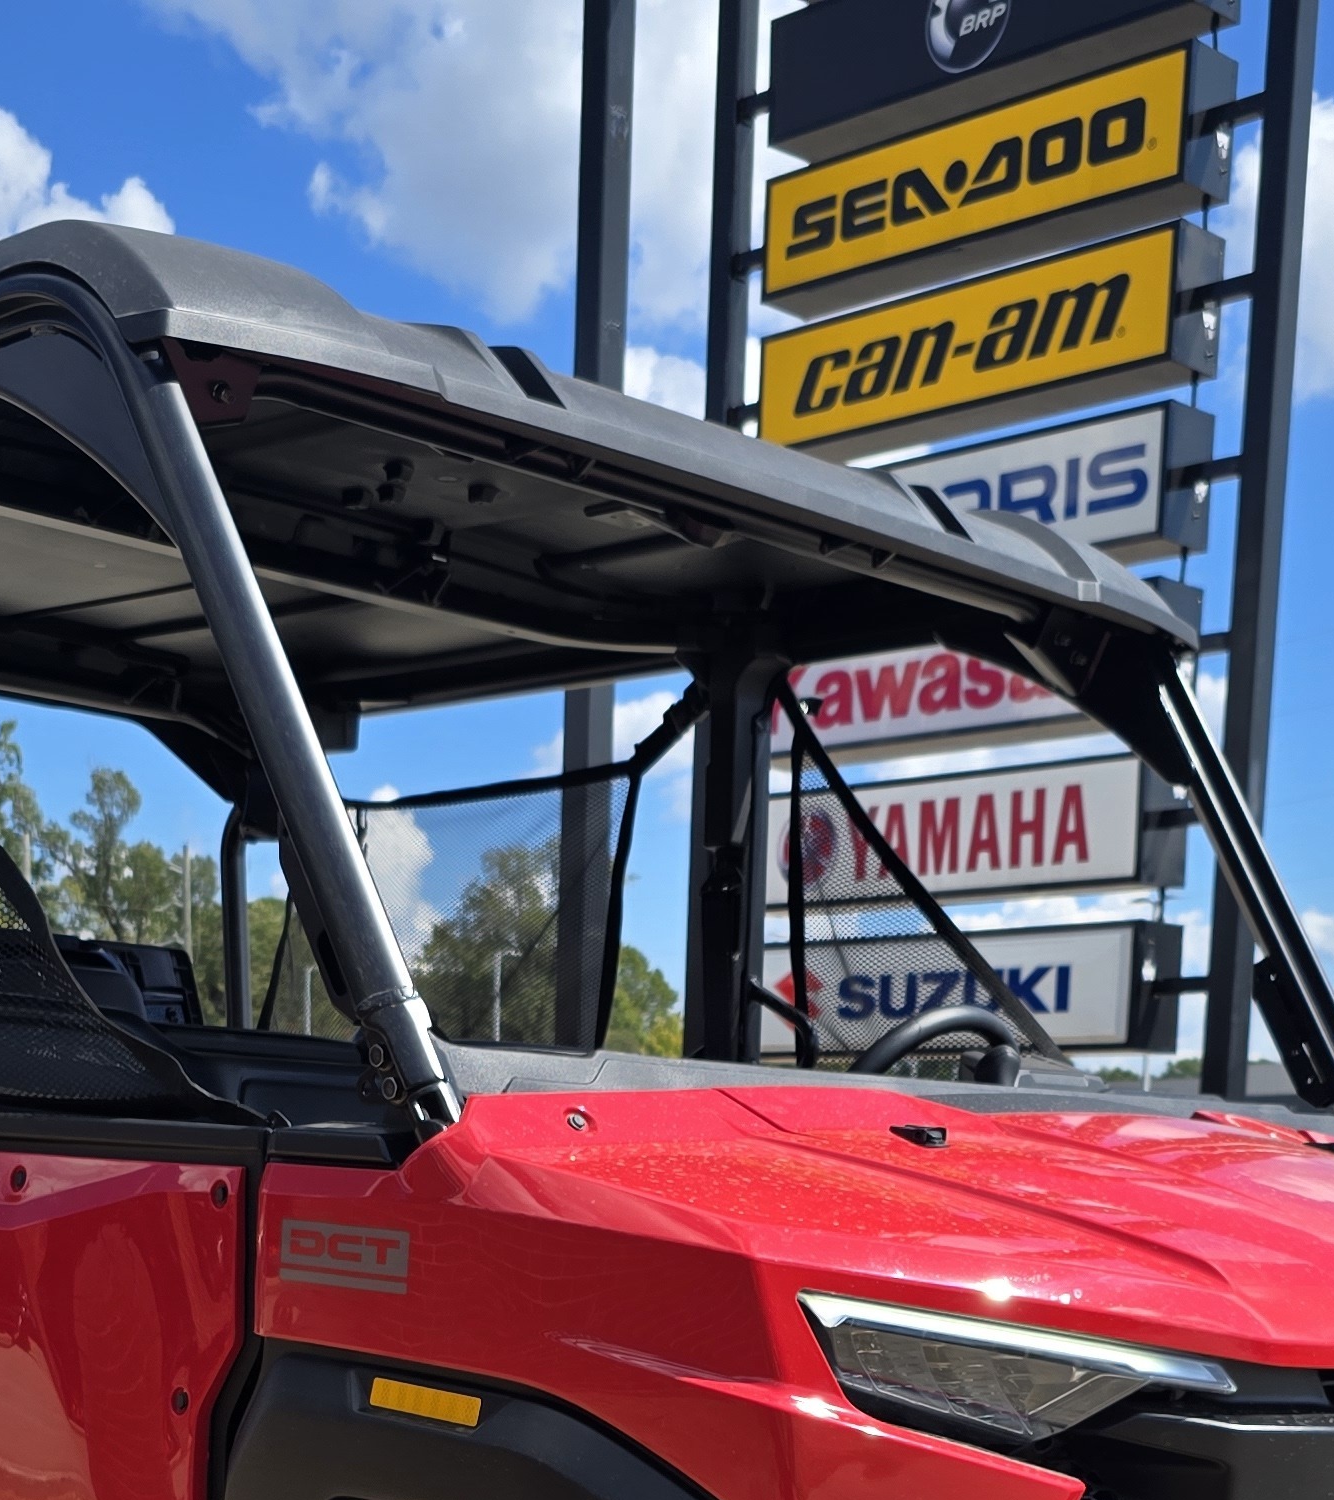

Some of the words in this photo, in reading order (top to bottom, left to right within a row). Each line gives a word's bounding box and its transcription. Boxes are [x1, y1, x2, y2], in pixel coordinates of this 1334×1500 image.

[959, 3, 1007, 37] BRP
[793, 273, 1130, 418] can-am
[847, 784, 1089, 881] YAMAHA
[290, 1229, 400, 1265] DCT
